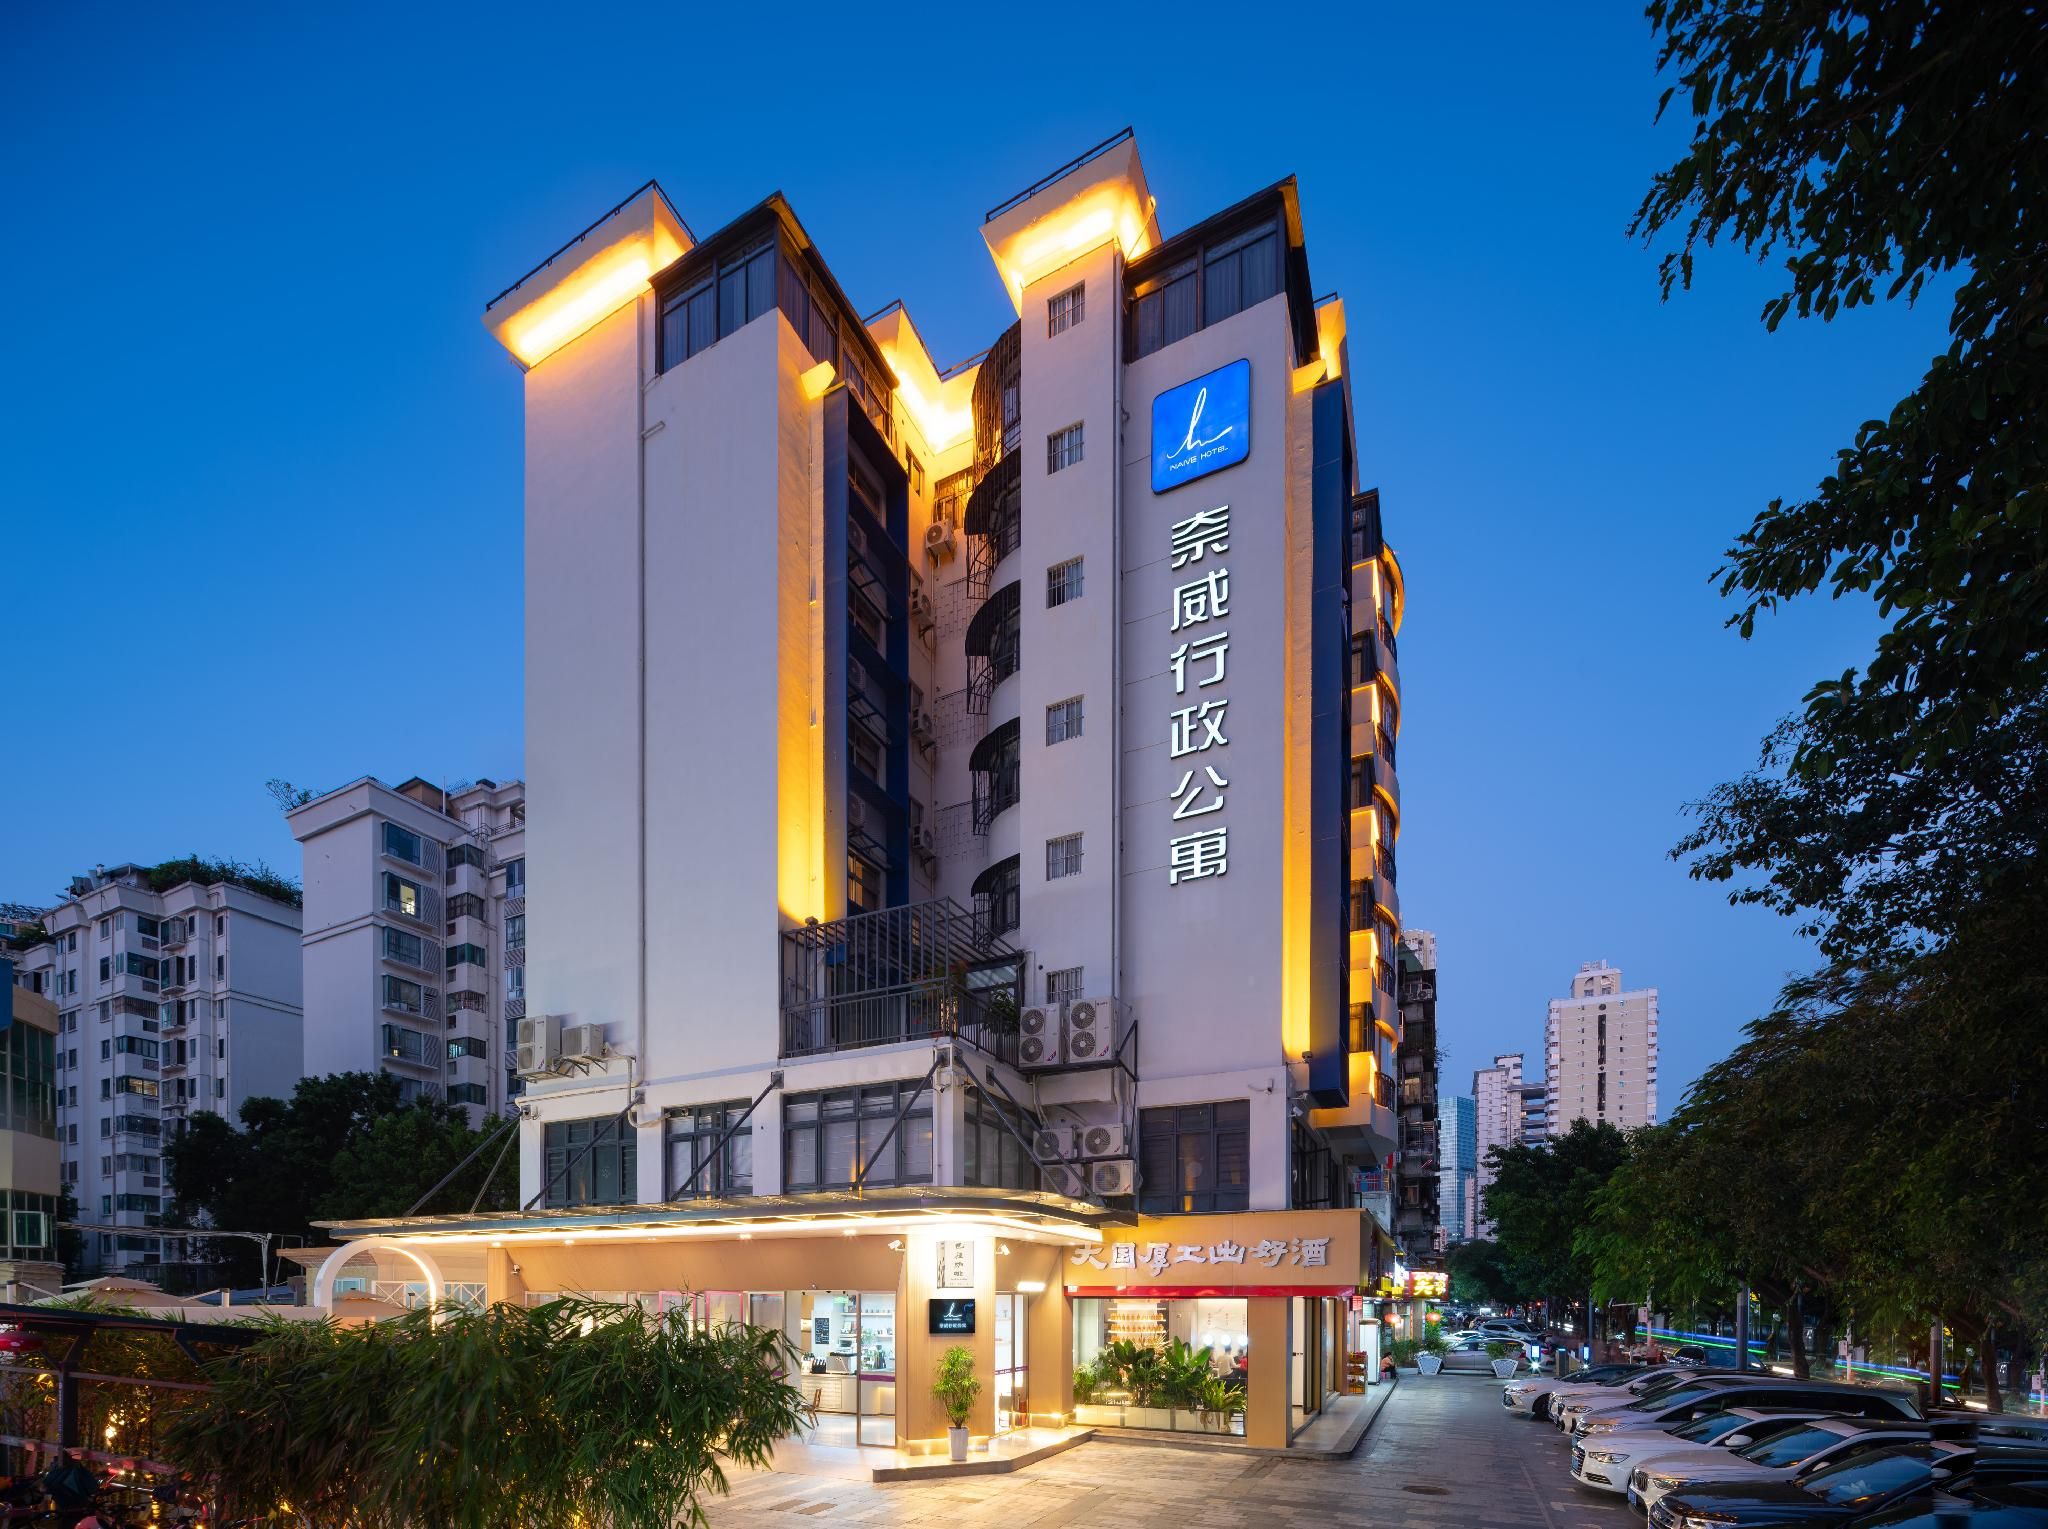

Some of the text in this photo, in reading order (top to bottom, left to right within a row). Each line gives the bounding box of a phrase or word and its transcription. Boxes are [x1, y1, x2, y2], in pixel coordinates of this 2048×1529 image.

[1200, 445, 1229, 460] HOTEL
[1170, 504, 1229, 886] 奈威行政公寓
